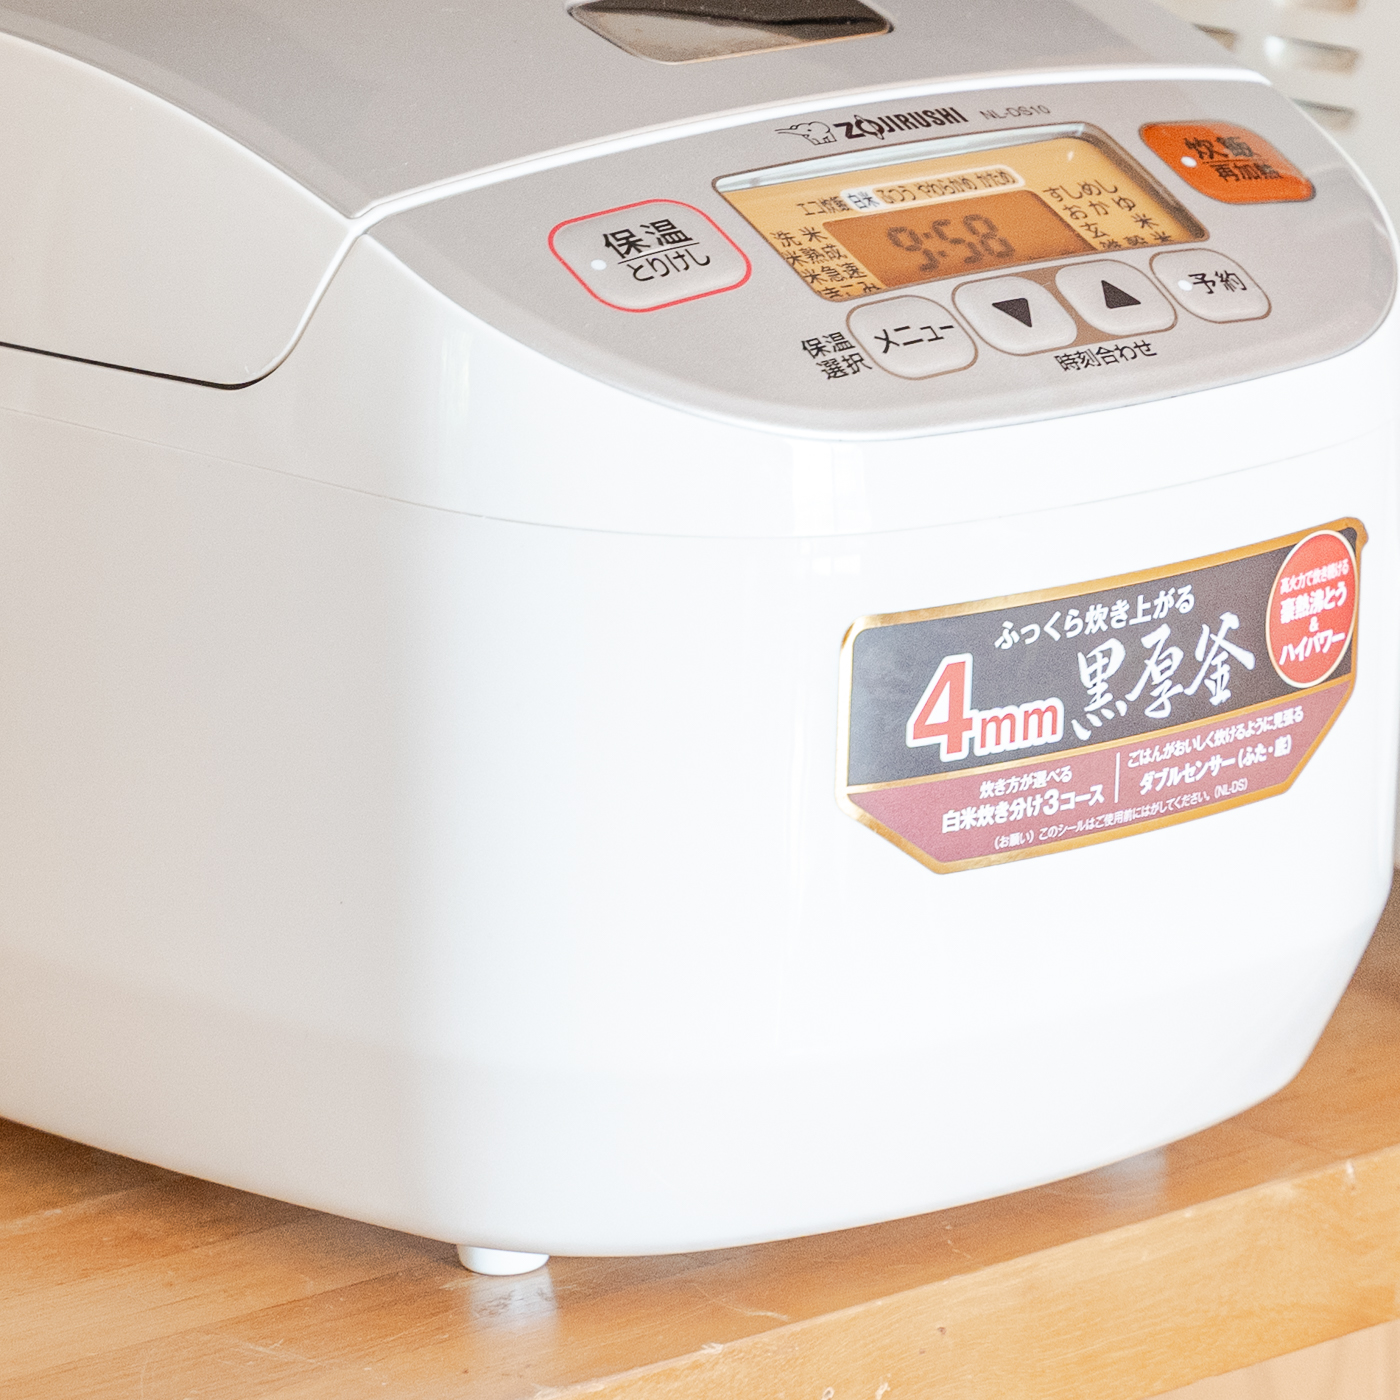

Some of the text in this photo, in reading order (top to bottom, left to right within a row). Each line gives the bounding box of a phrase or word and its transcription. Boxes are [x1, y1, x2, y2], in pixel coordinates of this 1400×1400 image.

[833, 104, 1051, 140] ZOJIRUSHI NL-DS10
[1043, 179, 1118, 202] すしめし
[1063, 195, 1136, 221] おかゆ
[602, 218, 693, 259] 保温
[886, 213, 1016, 273] 9:58
[626, 248, 711, 282] とりけし
[1190, 270, 1248, 296] 予約
[800, 330, 856, 361] 保温
[873, 323, 956, 354] メニュー
[816, 352, 873, 381] 選択
[1054, 339, 1158, 373] 時刻合わせ
[994, 584, 1195, 650] ふっくら炊き上がる
[1308, 615, 1319, 632] &
[1279, 629, 1345, 666] ハイパワー
[908, 611, 1256, 761] 4mm 黒厚釜
[1128, 705, 1304, 768] ごはんがおいしく炊けるように見張る
[979, 765, 1073, 799] 炊き方が選べる
[941, 784, 1105, 834] 白米炊き分け3コース
